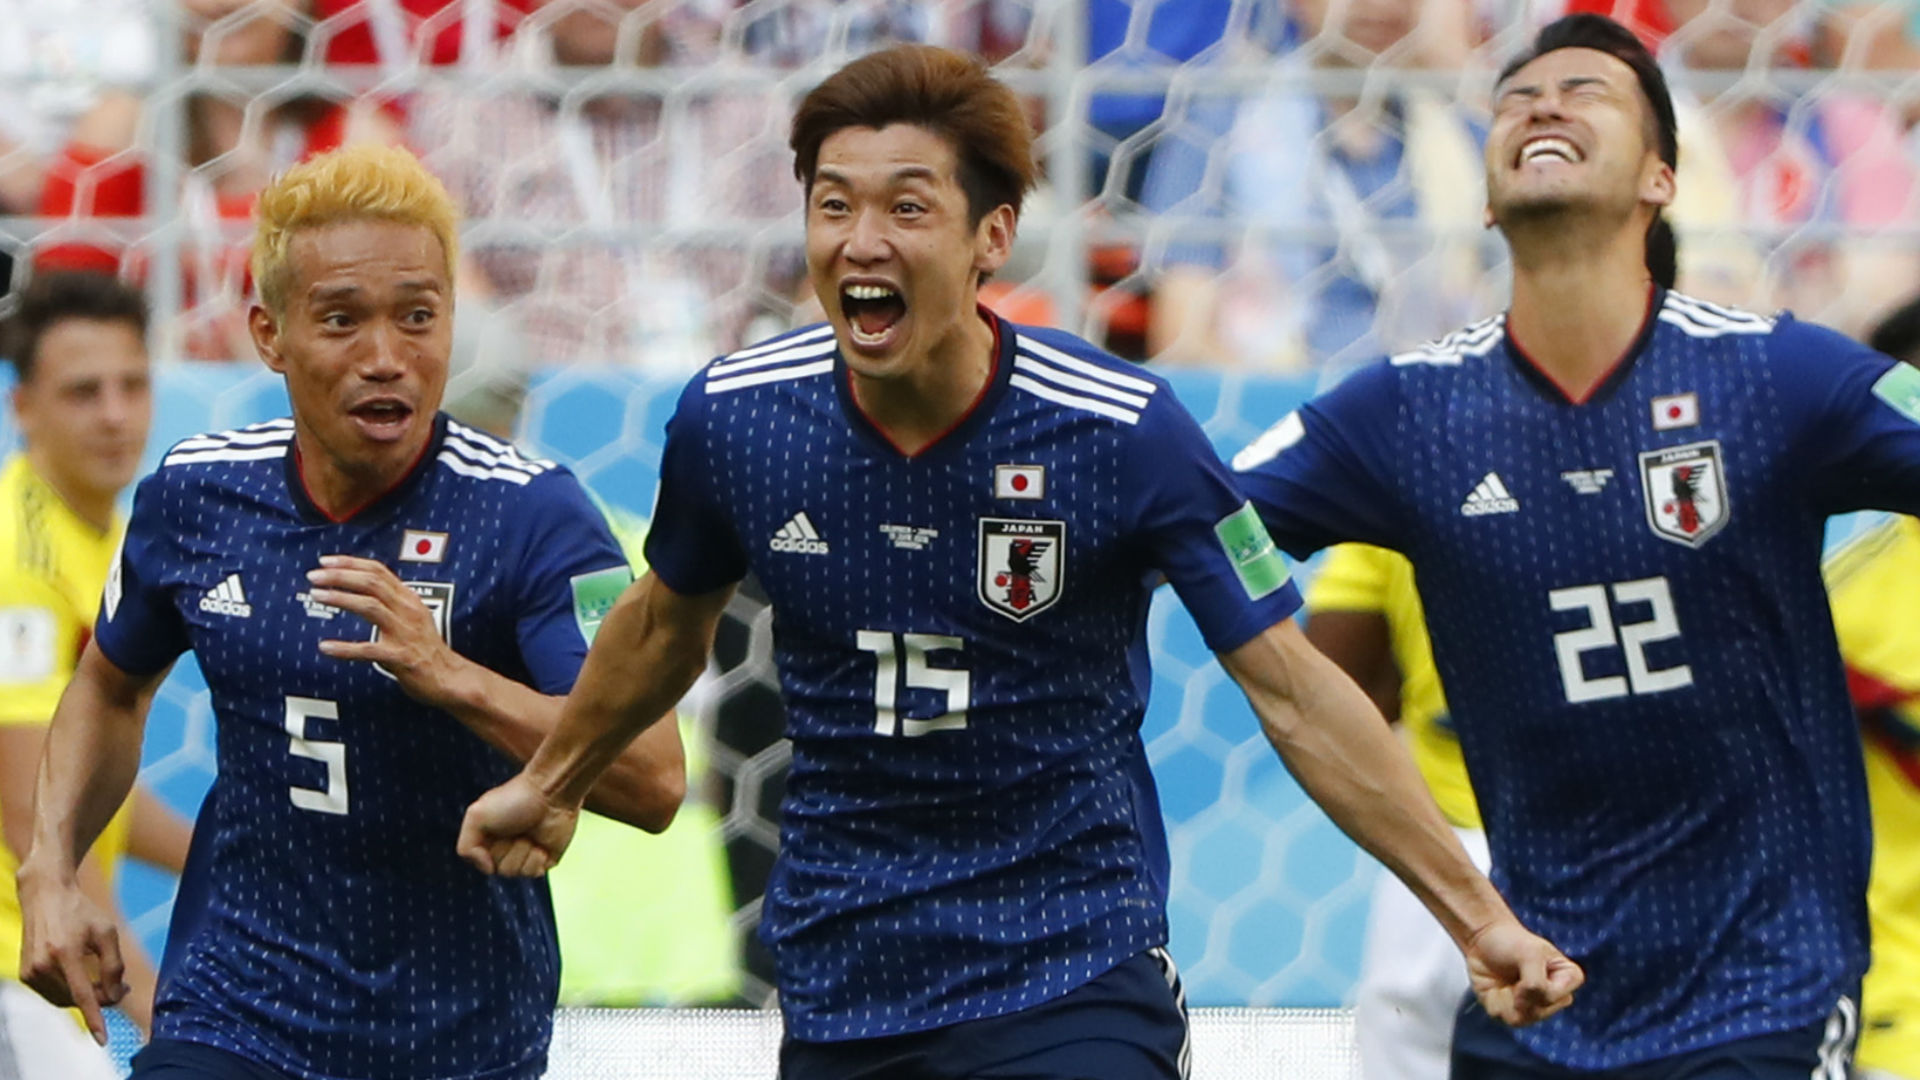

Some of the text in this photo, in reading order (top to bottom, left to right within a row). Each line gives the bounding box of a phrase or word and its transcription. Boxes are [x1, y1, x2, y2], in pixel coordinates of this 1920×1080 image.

[1461, 497, 1520, 517] adidas
[1001, 524, 1042, 533] JAPAN
[770, 537, 829, 555] adidas
[199, 597, 251, 618] adidas
[1549, 576, 1693, 704] 22
[857, 630, 970, 737] 15
[285, 695, 349, 816] 5
